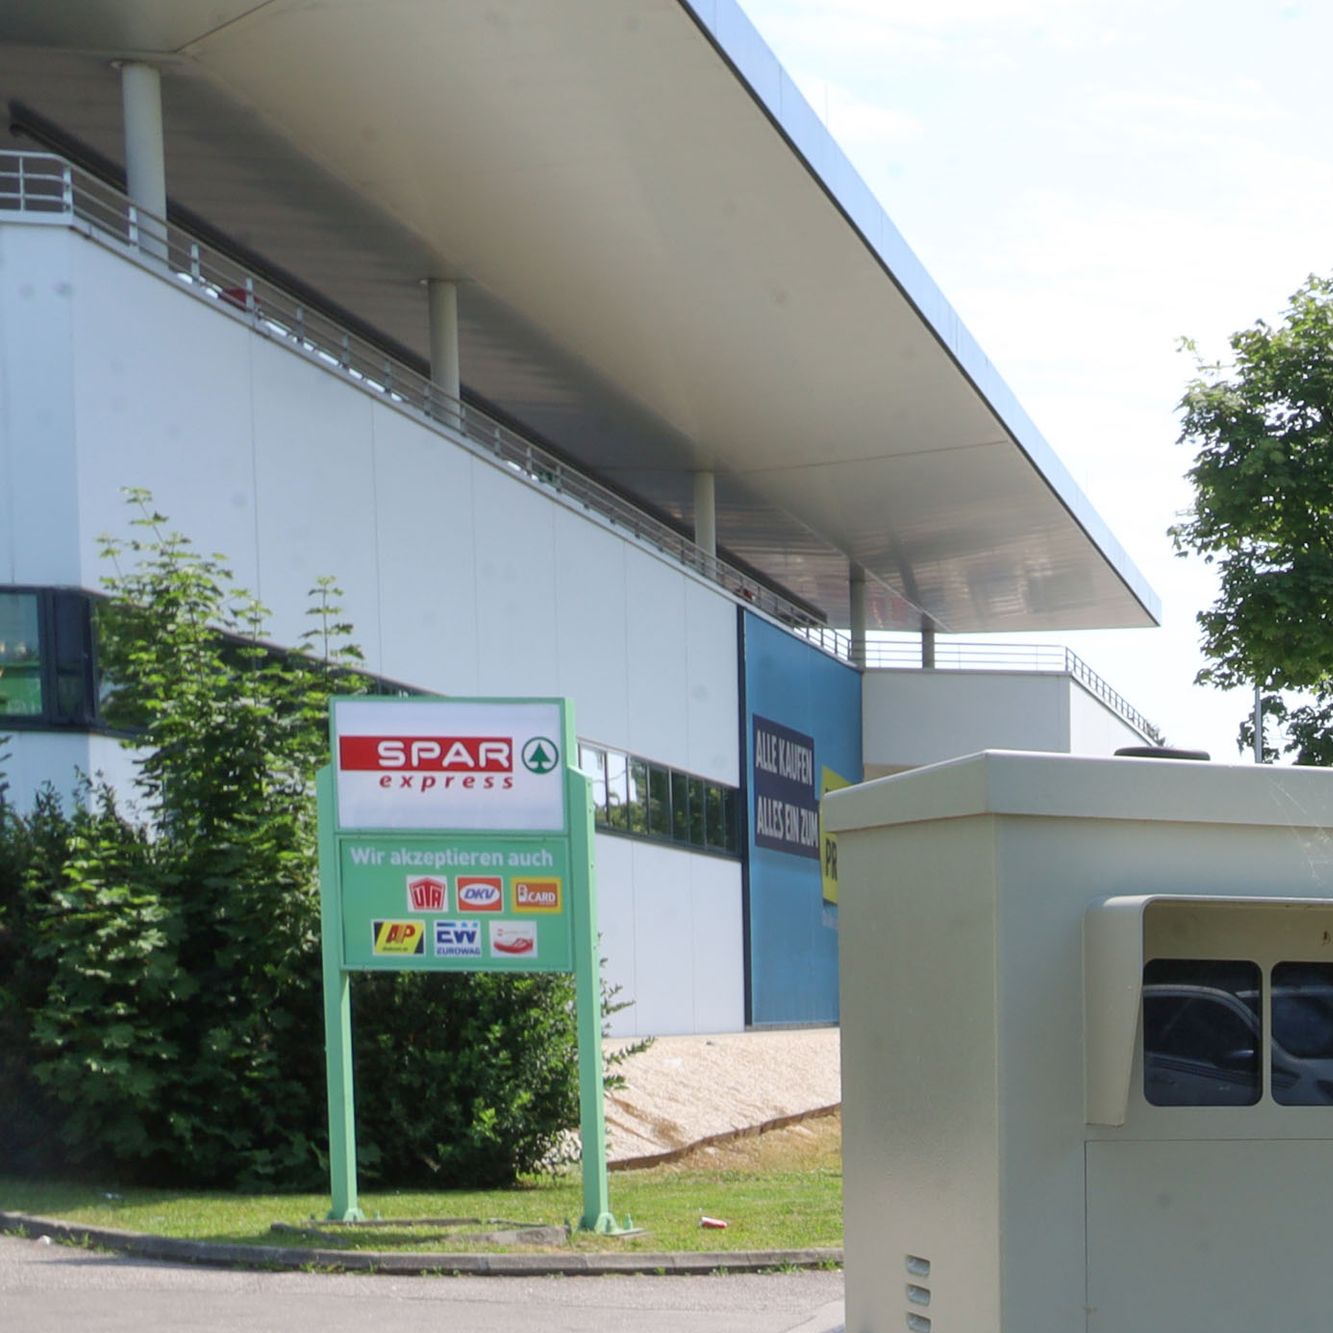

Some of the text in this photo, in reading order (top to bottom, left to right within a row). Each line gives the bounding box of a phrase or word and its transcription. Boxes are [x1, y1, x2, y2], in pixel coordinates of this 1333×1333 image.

[377, 740, 510, 768] SPAR
[756, 730, 813, 786] ALLE KAUFEN
[379, 774, 513, 792] express
[757, 796, 819, 848] ALLES EIN ZUM
[350, 847, 554, 869] Wir akzeptieren auch
[463, 887, 496, 900] DKV
[436, 946, 481, 956] EUROWAG
